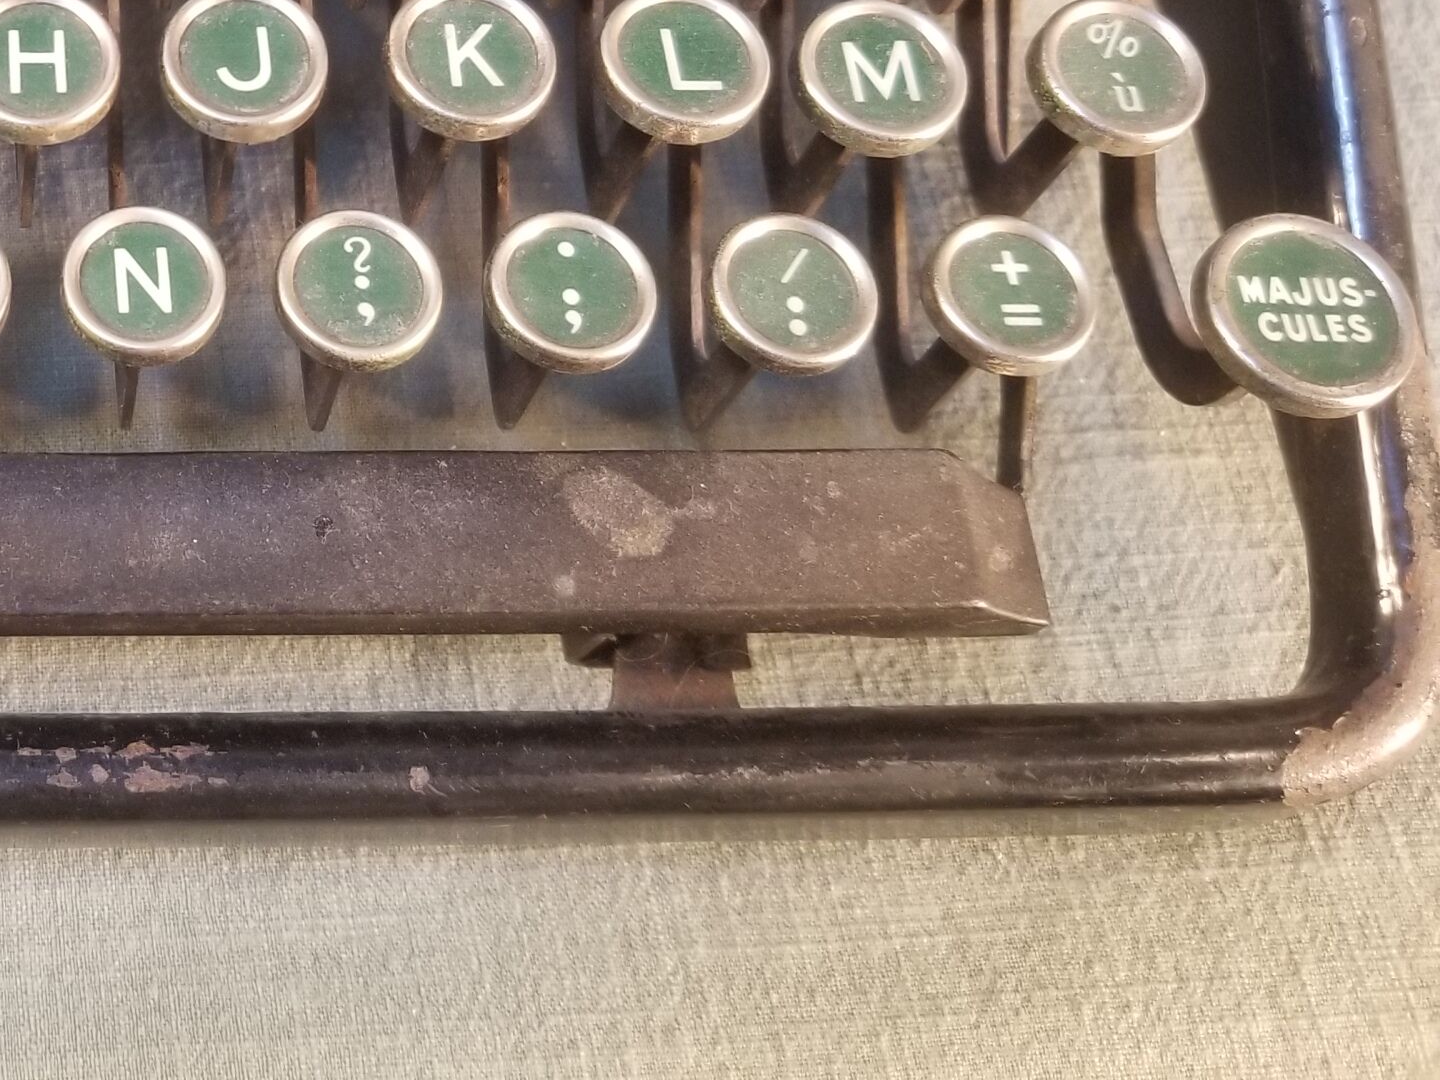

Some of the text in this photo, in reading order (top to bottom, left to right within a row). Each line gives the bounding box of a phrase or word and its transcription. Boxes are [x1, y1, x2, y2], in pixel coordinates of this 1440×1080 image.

[8, 29, 68, 94] H
[216, 26, 272, 92] J
[444, 23, 505, 87] K
[659, 28, 724, 91] L
[1086, 20, 1139, 59] %
[841, 40, 921, 103] M
[113, 247, 173, 314] N
[1236, 275, 1376, 307] MAJUS-
[1257, 312, 1373, 343] CULES
